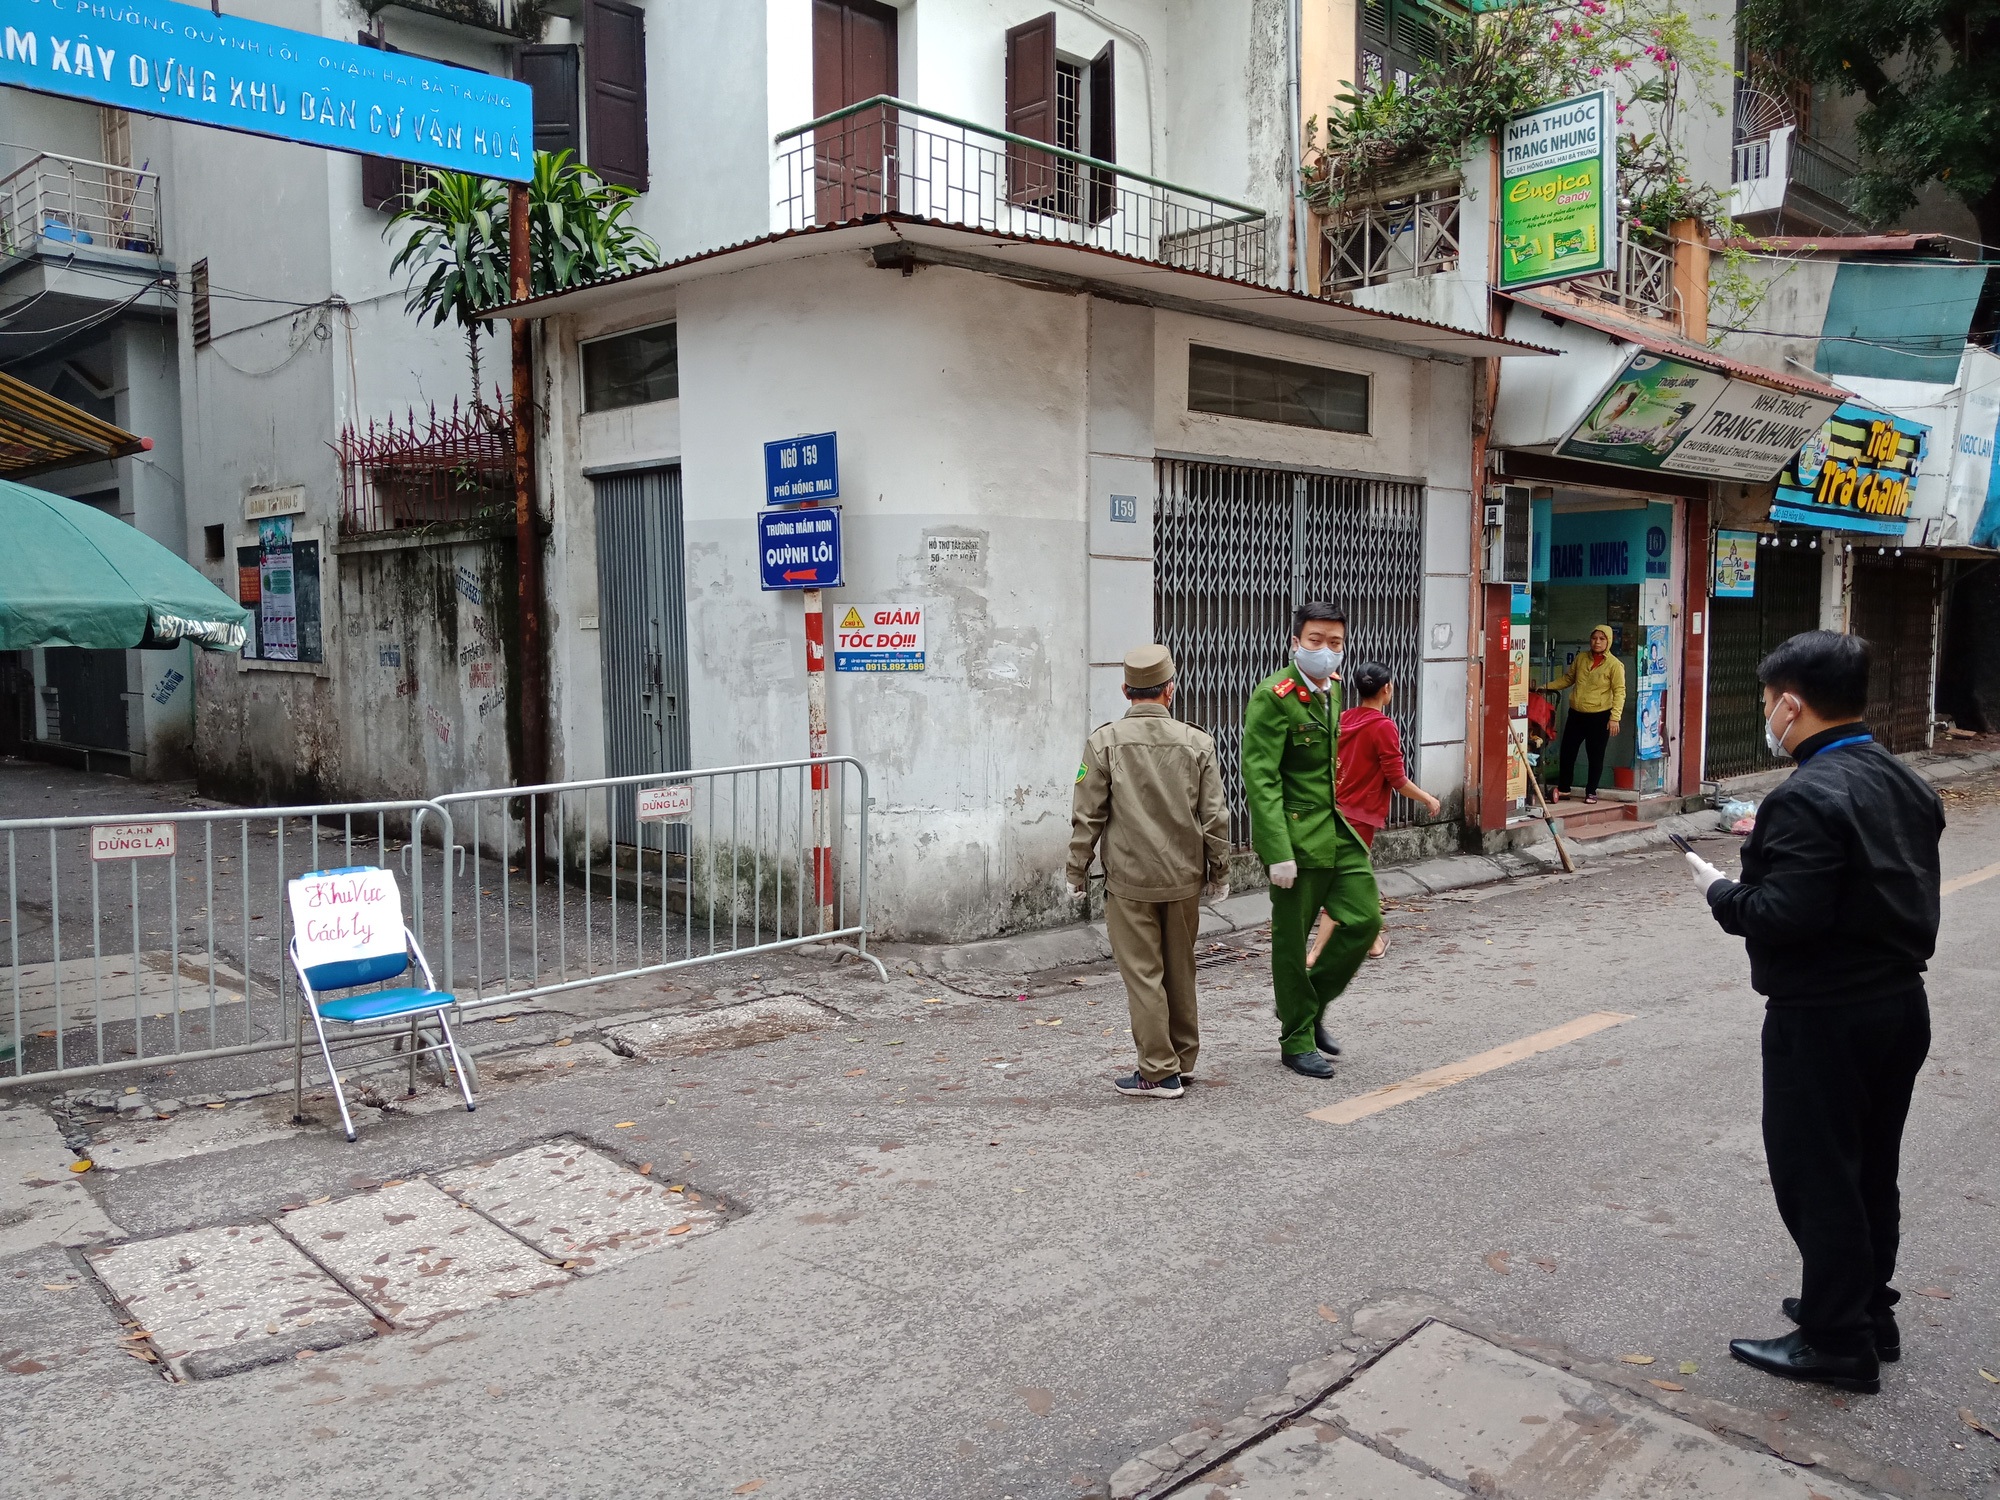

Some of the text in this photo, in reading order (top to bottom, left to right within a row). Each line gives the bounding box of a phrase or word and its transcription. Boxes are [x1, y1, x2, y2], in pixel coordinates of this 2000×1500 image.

[51, 34, 115, 82] XÂY
[129, 54, 216, 103] DỰNG
[301, 86, 356, 130] DÂN
[370, 104, 404, 139] CƯ
[414, 108, 462, 150] VĂN
[383, 69, 414, 86] HAI
[421, 76, 443, 94] BÀ
[1509, 105, 1596, 141] NHÀ THUỐC
[1507, 126, 1596, 162] TRANG NHUNG
[1557, 154, 1568, 162] HAI
[1509, 174, 1592, 203] Eugica
[1556, 190, 1592, 205] Candy
[1751, 394, 1812, 419] NHÀ THUỐC
[1701, 410, 1764, 441] TRANG
[1750, 421, 1811, 450] NHUNG
[1683, 439, 1712, 453] CHUYÊN
[1867, 420, 1900, 469] Tiệm
[1978, 438, 1992, 458] LAN
[780, 443, 818, 469] NGÕ 159
[774, 479, 832, 497] PHỐ HỒNG MAI
[1818, 456, 1859, 507] Trà
[1114, 499, 1134, 517] 159
[766, 521, 794, 536] TRƯỜNG
[815, 519, 832, 532] NON
[1649, 534, 1663, 551] 161
[766, 541, 833, 567] QUỲNH LÔI
[931, 553, 940, 562] 50
[1551, 541, 1628, 578] TRANG NHUNG
[873, 608, 921, 625] GIẢM
[838, 629, 917, 650] TỐC ĐỘ!!!
[865, 663, 925, 671] 0915.892.689
[642, 798, 689, 811] DỪNG LẠI
[116, 827, 153, 836] C.A.H.N
[98, 837, 170, 851] DỪNG LẠI
[305, 882, 354, 908] Khu
[307, 916, 350, 942] Cách
